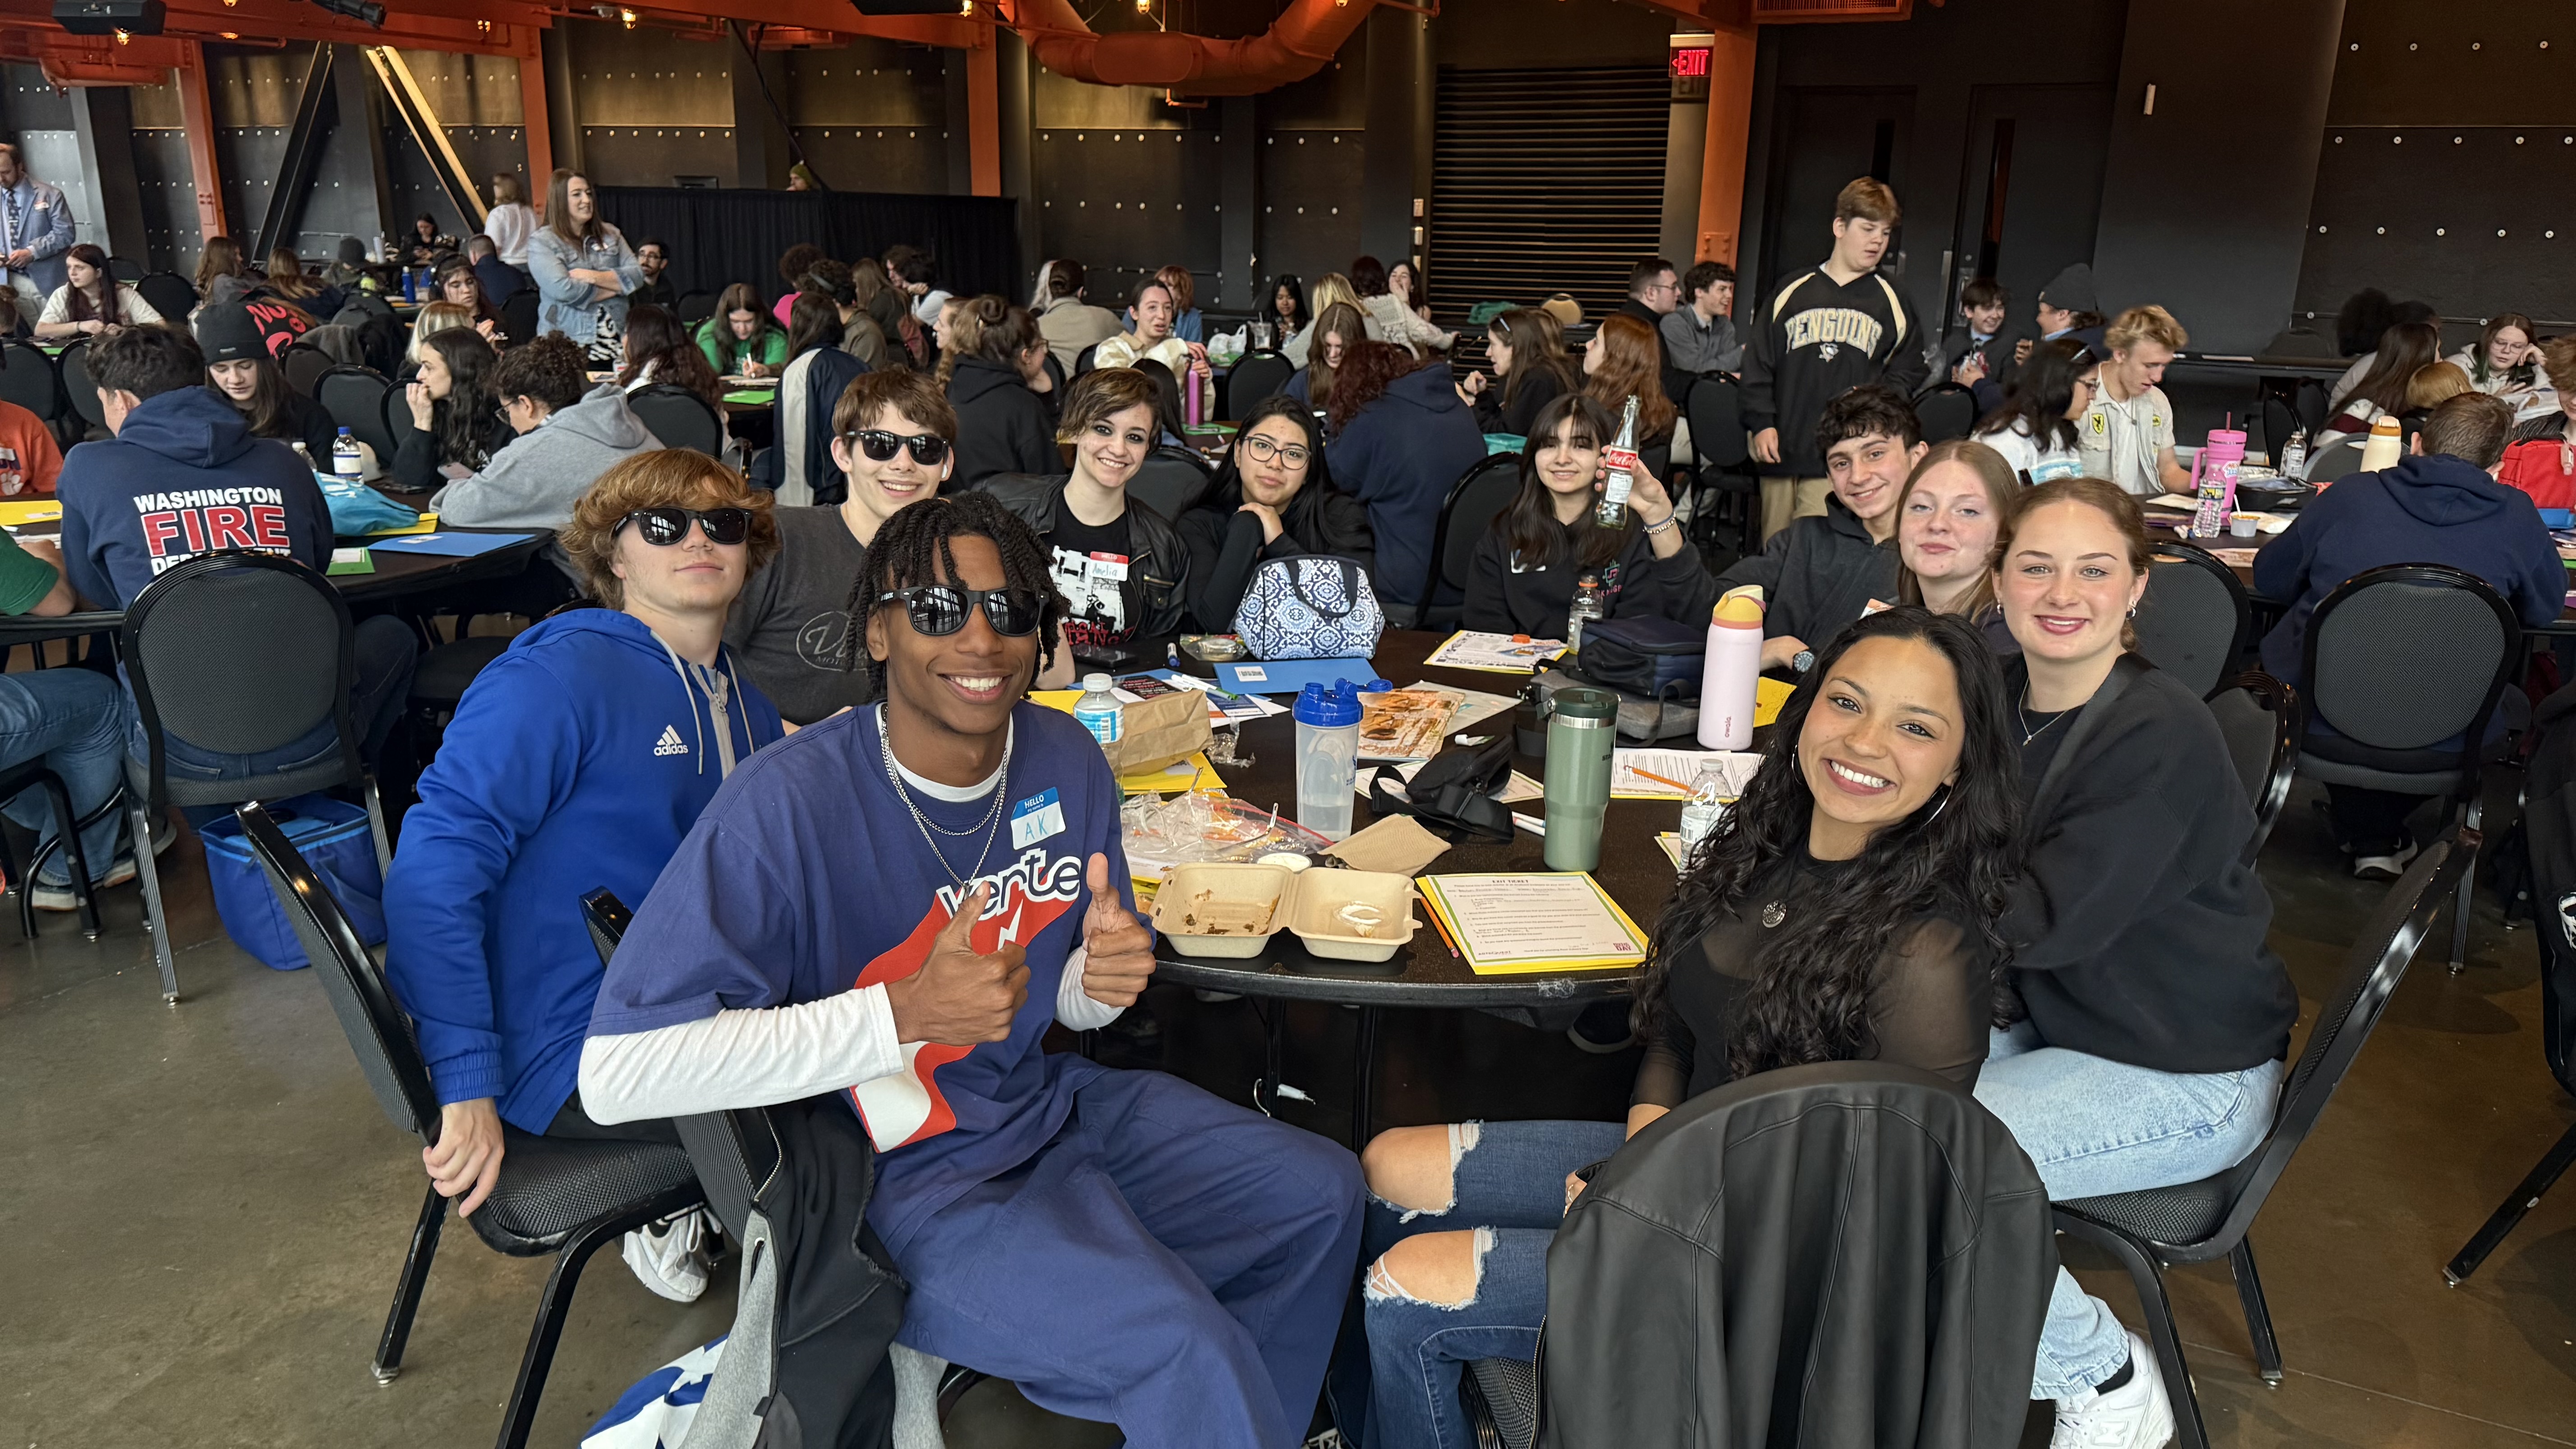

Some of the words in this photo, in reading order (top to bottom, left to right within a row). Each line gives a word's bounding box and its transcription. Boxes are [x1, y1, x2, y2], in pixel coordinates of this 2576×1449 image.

[1678, 50, 1708, 75] EXIT
[1784, 307, 1883, 360] PENGUINS
[1609, 452, 1636, 466] Coca-Co
[133, 487, 283, 513] WASHINGTON
[140, 504, 290, 557] FIRE
[653, 743, 689, 756] adidas
[1024, 795, 1044, 809] HELLO
